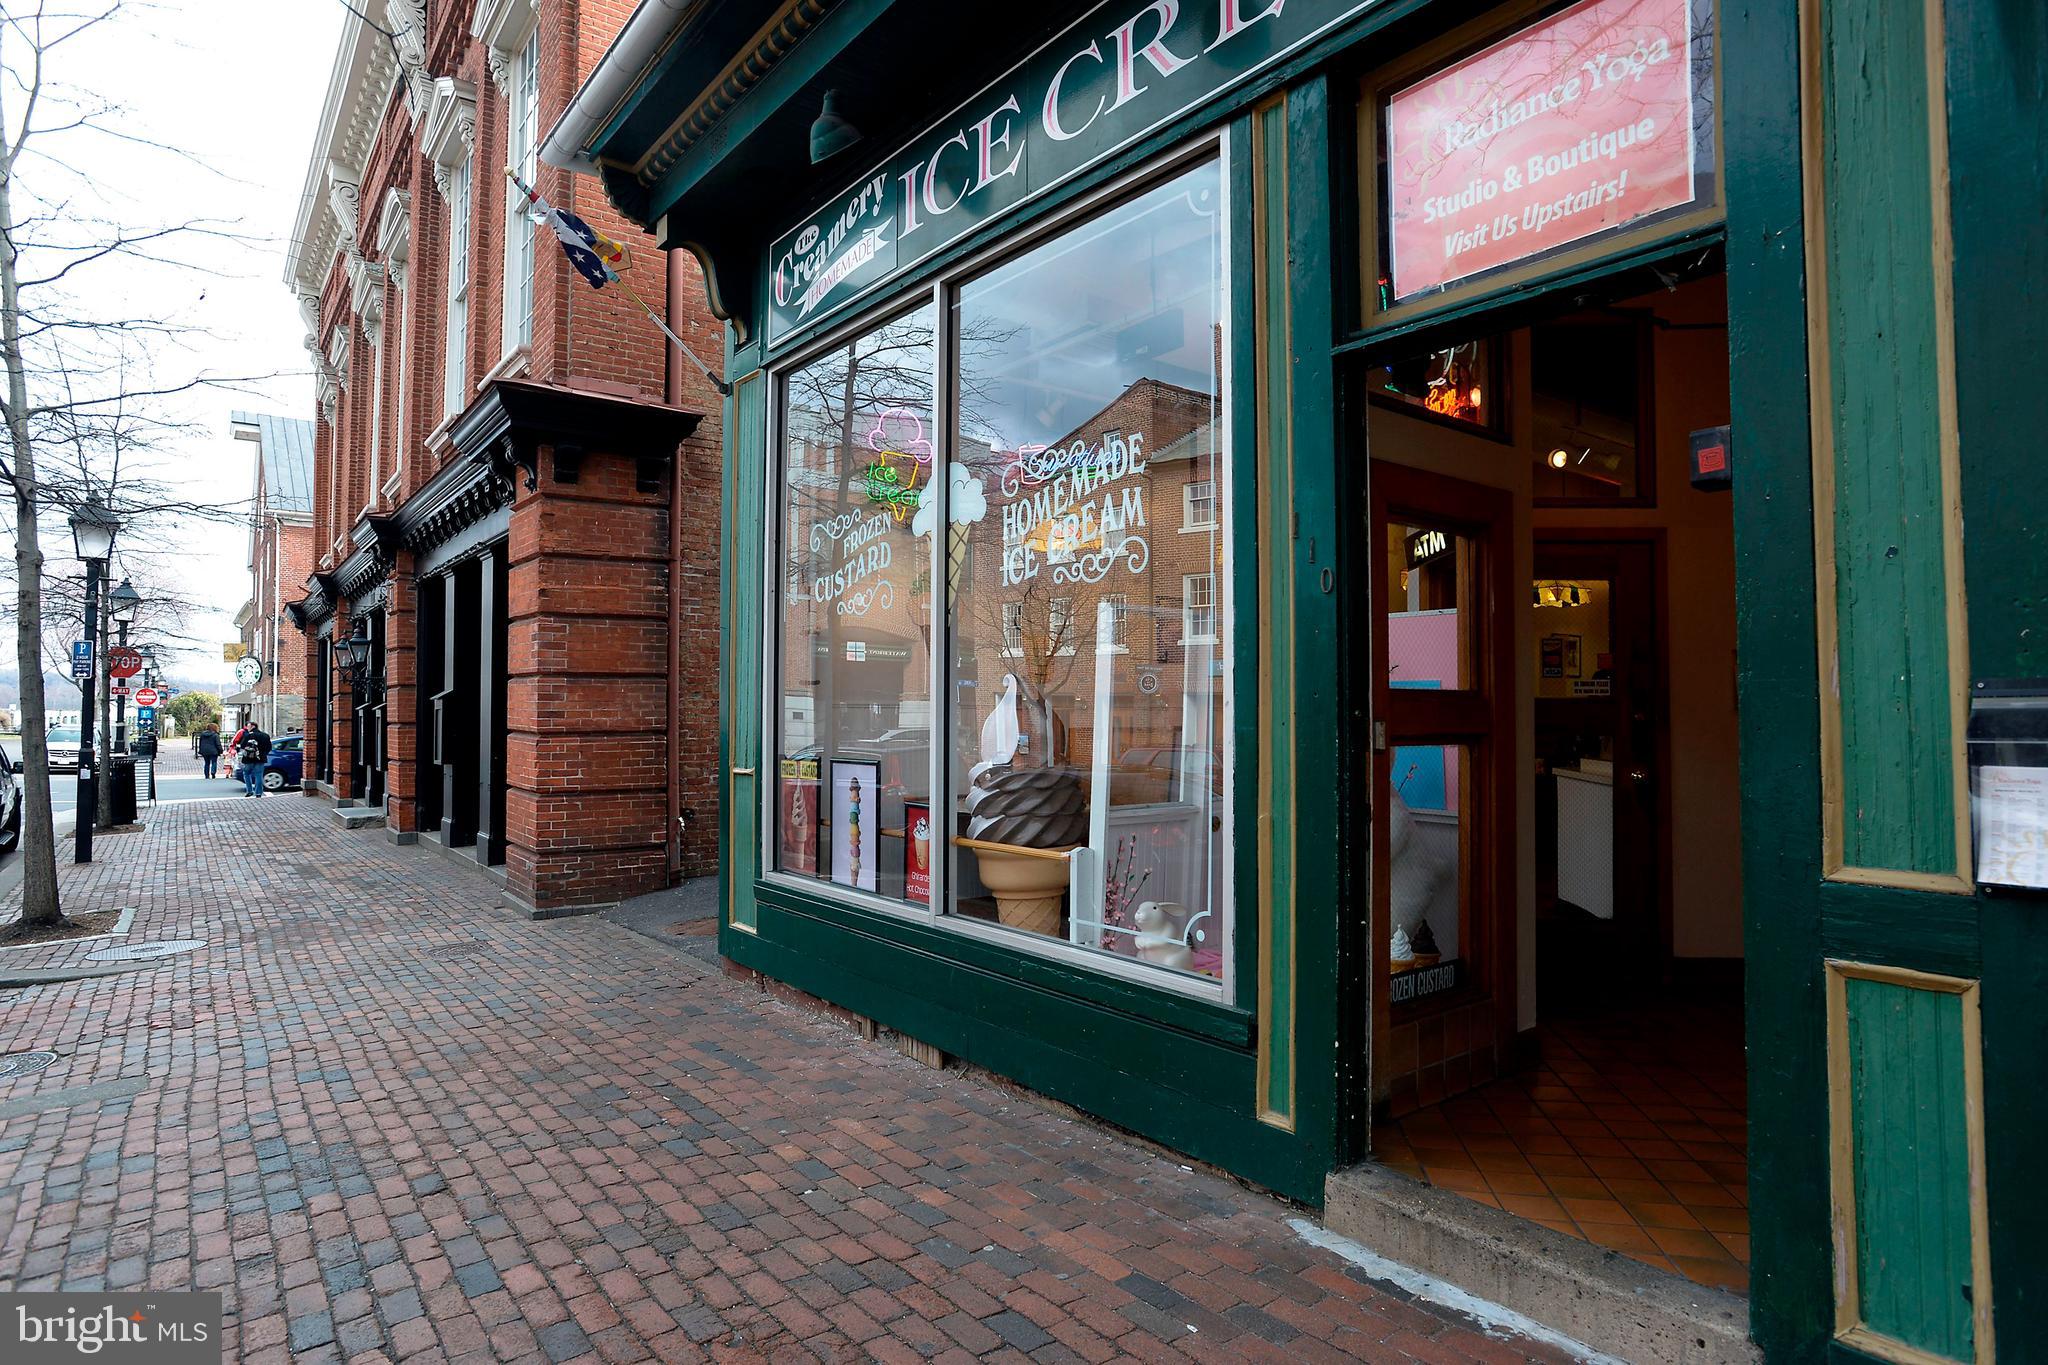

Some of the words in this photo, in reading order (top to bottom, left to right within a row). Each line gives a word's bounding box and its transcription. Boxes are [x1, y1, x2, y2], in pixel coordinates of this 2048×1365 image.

[1443, 76, 1582, 155] Radiance
[1581, 36, 1671, 93] Yoga
[897, 94, 1026, 241] ICE
[1422, 177, 1498, 224] Studio
[1503, 165, 1523, 193] &
[1526, 117, 1655, 185] Boutique
[775, 172, 888, 307] Creamery
[798, 229, 817, 251] The
[1444, 222, 1490, 258] Visit
[1492, 214, 1518, 241] Us
[1522, 169, 1629, 232] Upstairs!
[811, 237, 872, 302] HOMEMADE
[866, 461, 898, 483] Ice
[1002, 431, 1146, 541] HOMEMADE
[843, 511, 892, 560] FROZEN
[1001, 539, 1040, 587] ICE
[1047, 486, 1146, 566] CREAM
[1414, 530, 1446, 562] ATM
[815, 541, 892, 603] CUSTARD
[79, 643, 87, 654] P
[1417, 964, 1455, 997] CUSTARD
